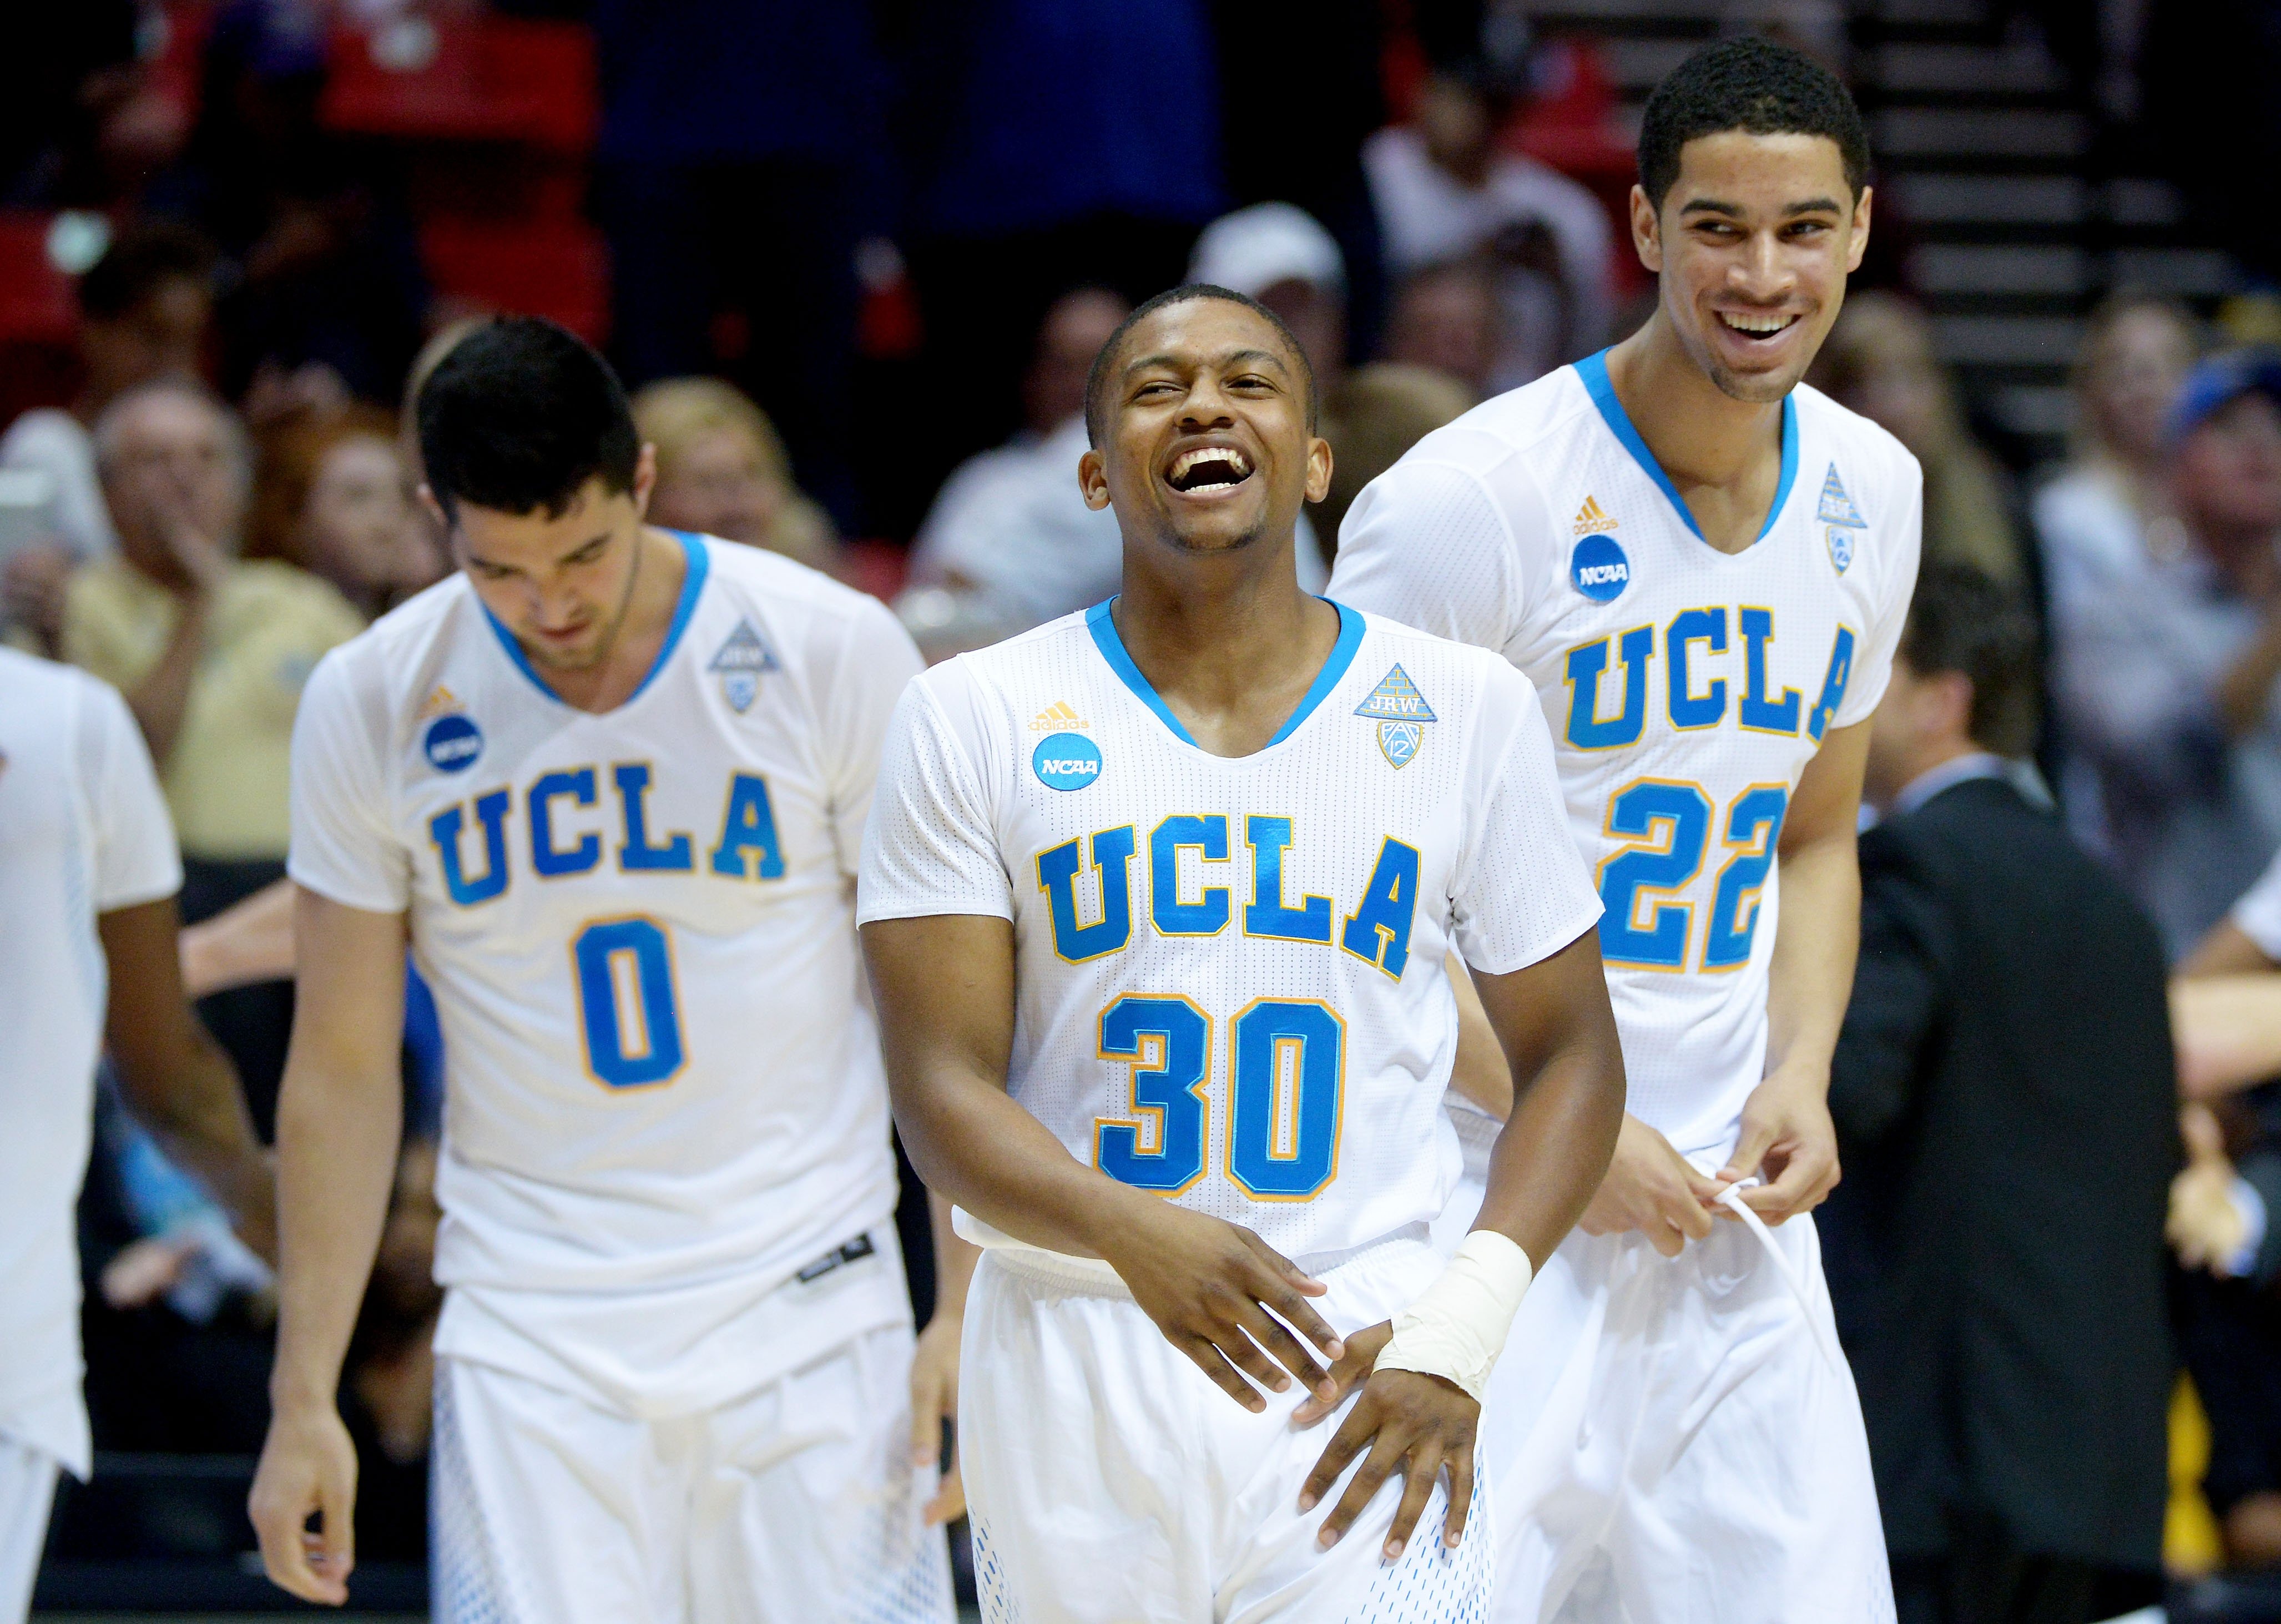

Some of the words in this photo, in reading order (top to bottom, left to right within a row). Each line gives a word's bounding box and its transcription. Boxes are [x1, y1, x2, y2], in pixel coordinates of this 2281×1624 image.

[1573, 518, 1619, 534] adidas
[1579, 563, 1628, 586] NCAA
[1369, 696, 1421, 713] JRW
[1562, 605, 1856, 752] UCLA
[1029, 719, 1090, 730] adidas
[1041, 759, 1098, 775] NCAA
[1389, 740, 1409, 758] 12
[428, 760, 787, 910] UCLA
[1594, 776, 1790, 974] 22
[1034, 812, 1422, 984] UCLA
[568, 911, 691, 1095] 0
[1092, 991, 1348, 1203] 30
